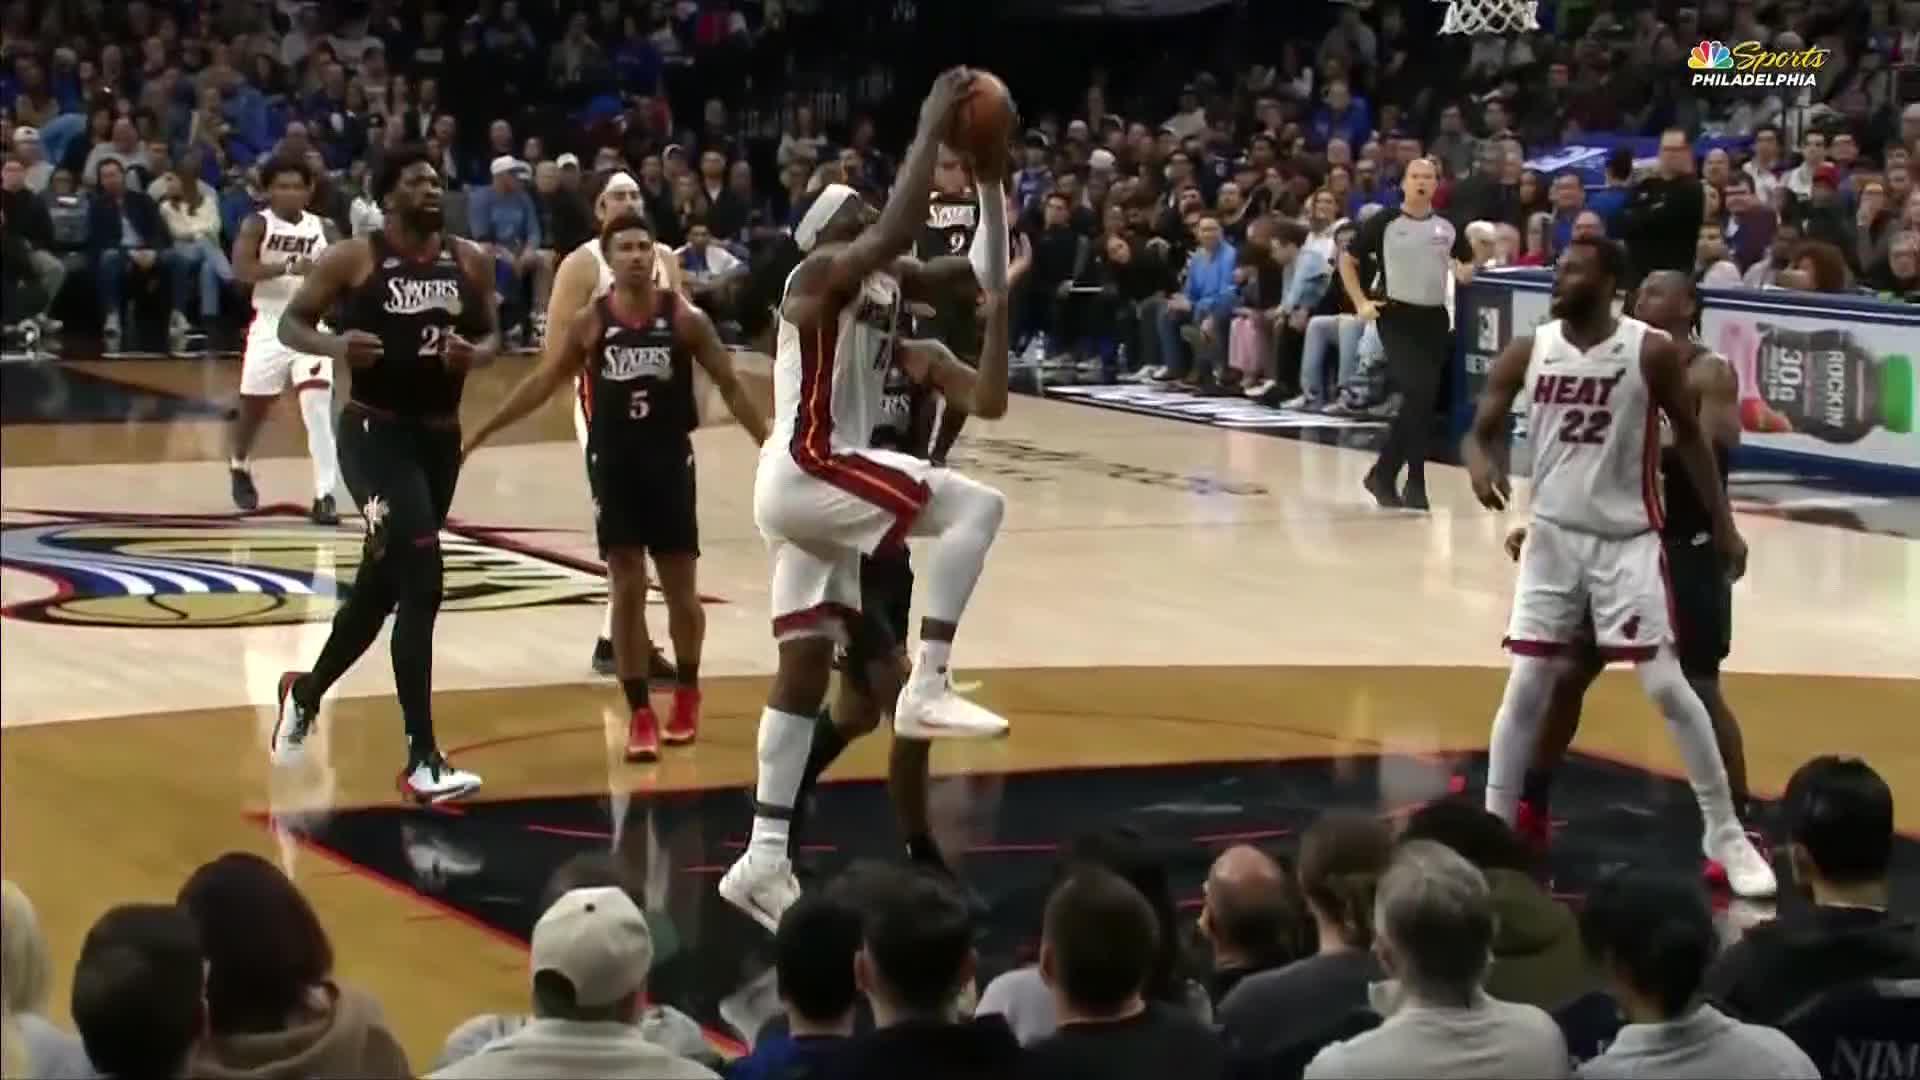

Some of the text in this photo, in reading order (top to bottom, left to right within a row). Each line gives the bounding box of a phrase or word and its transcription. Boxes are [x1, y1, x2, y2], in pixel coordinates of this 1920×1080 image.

[267, 233, 319, 254] HEAT
[384, 277, 460, 314] SIXERS
[601, 345, 671, 381] SIXERS
[629, 389, 650, 419] 5
[1533, 368, 1626, 406] HEAT
[1558, 409, 1612, 444] 22
